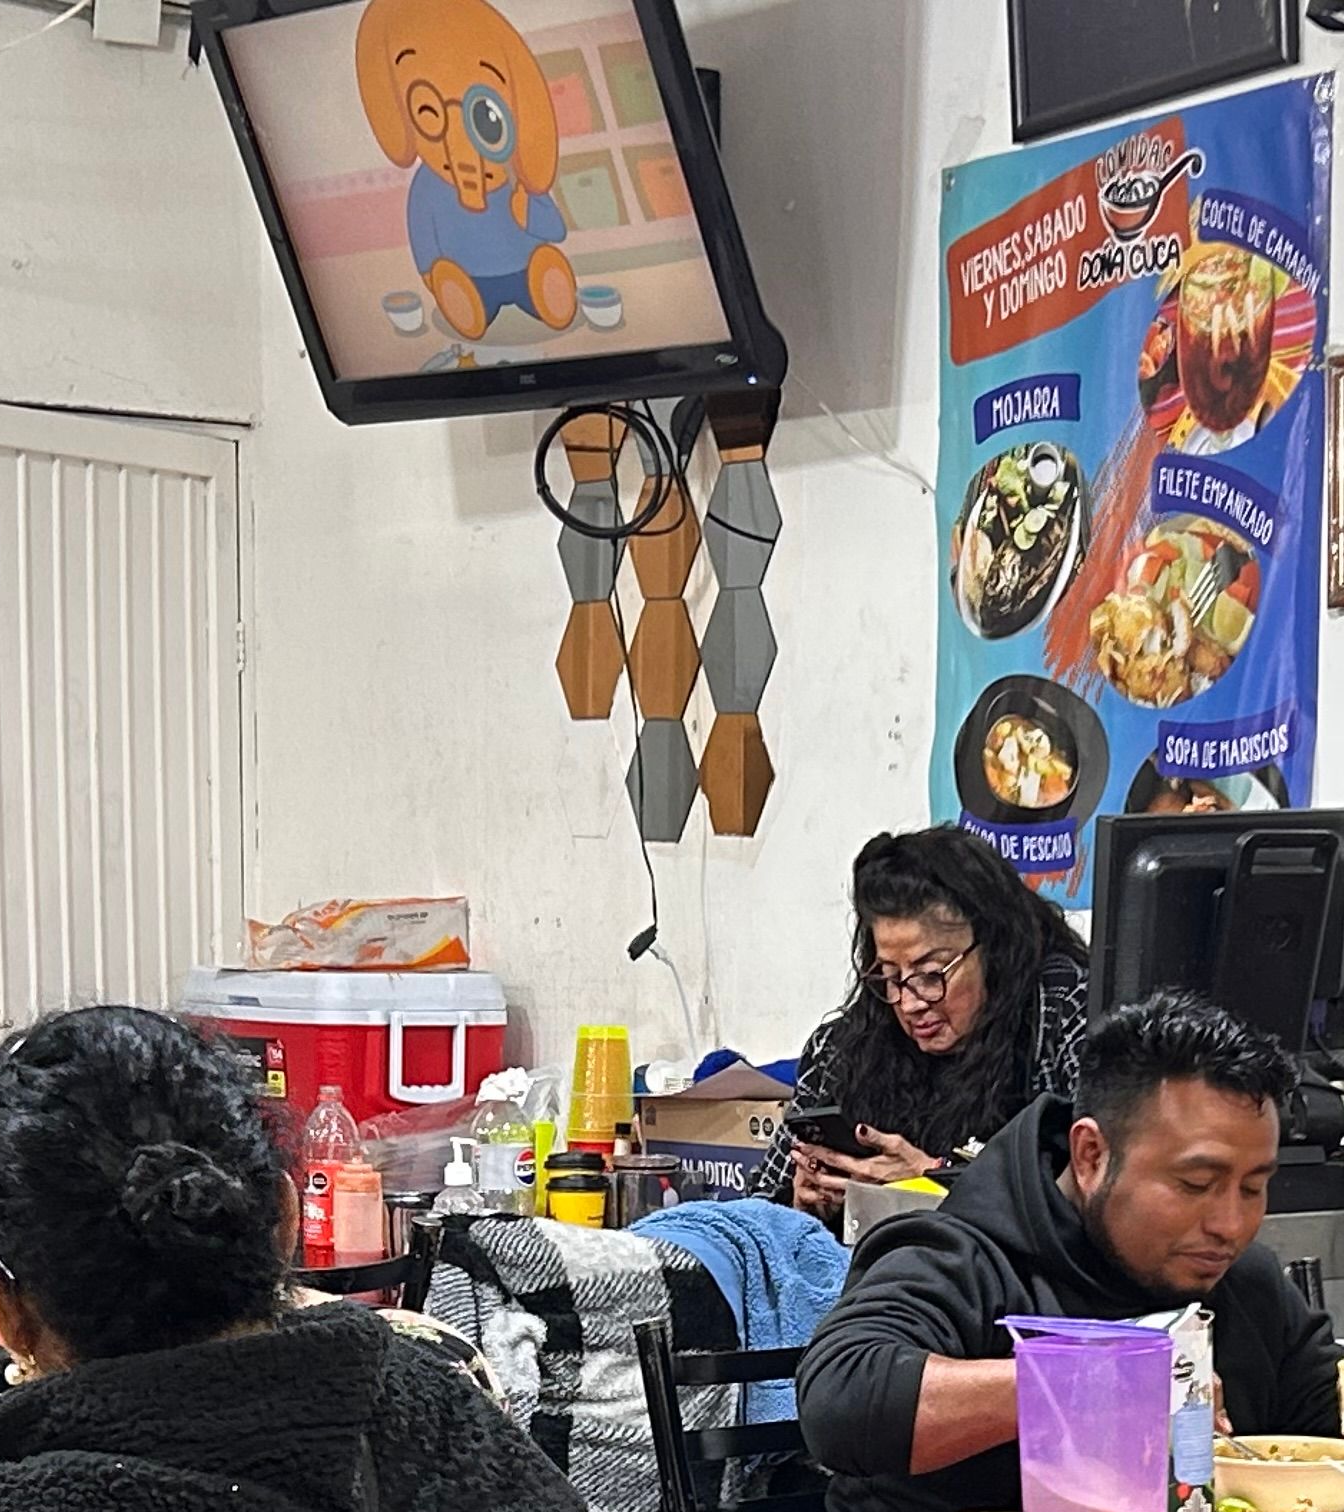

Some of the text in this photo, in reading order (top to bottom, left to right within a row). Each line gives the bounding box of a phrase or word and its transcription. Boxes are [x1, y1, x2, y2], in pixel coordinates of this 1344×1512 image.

[1129, 235, 1181, 278] CUCA
[1201, 197, 1321, 298] COCTEL DE CAMARON
[983, 249, 1067, 328] Y DOMINGO
[992, 385, 1061, 430] MOJARRA
[1158, 467, 1274, 545] FILETE EMPANIZADO
[1165, 724, 1289, 769] SOPA DE MARISCOS
[1000, 834, 1020, 859] DE
[1022, 832, 1072, 862] PESCADO
[681, 1158, 745, 1191] ALADITAS
